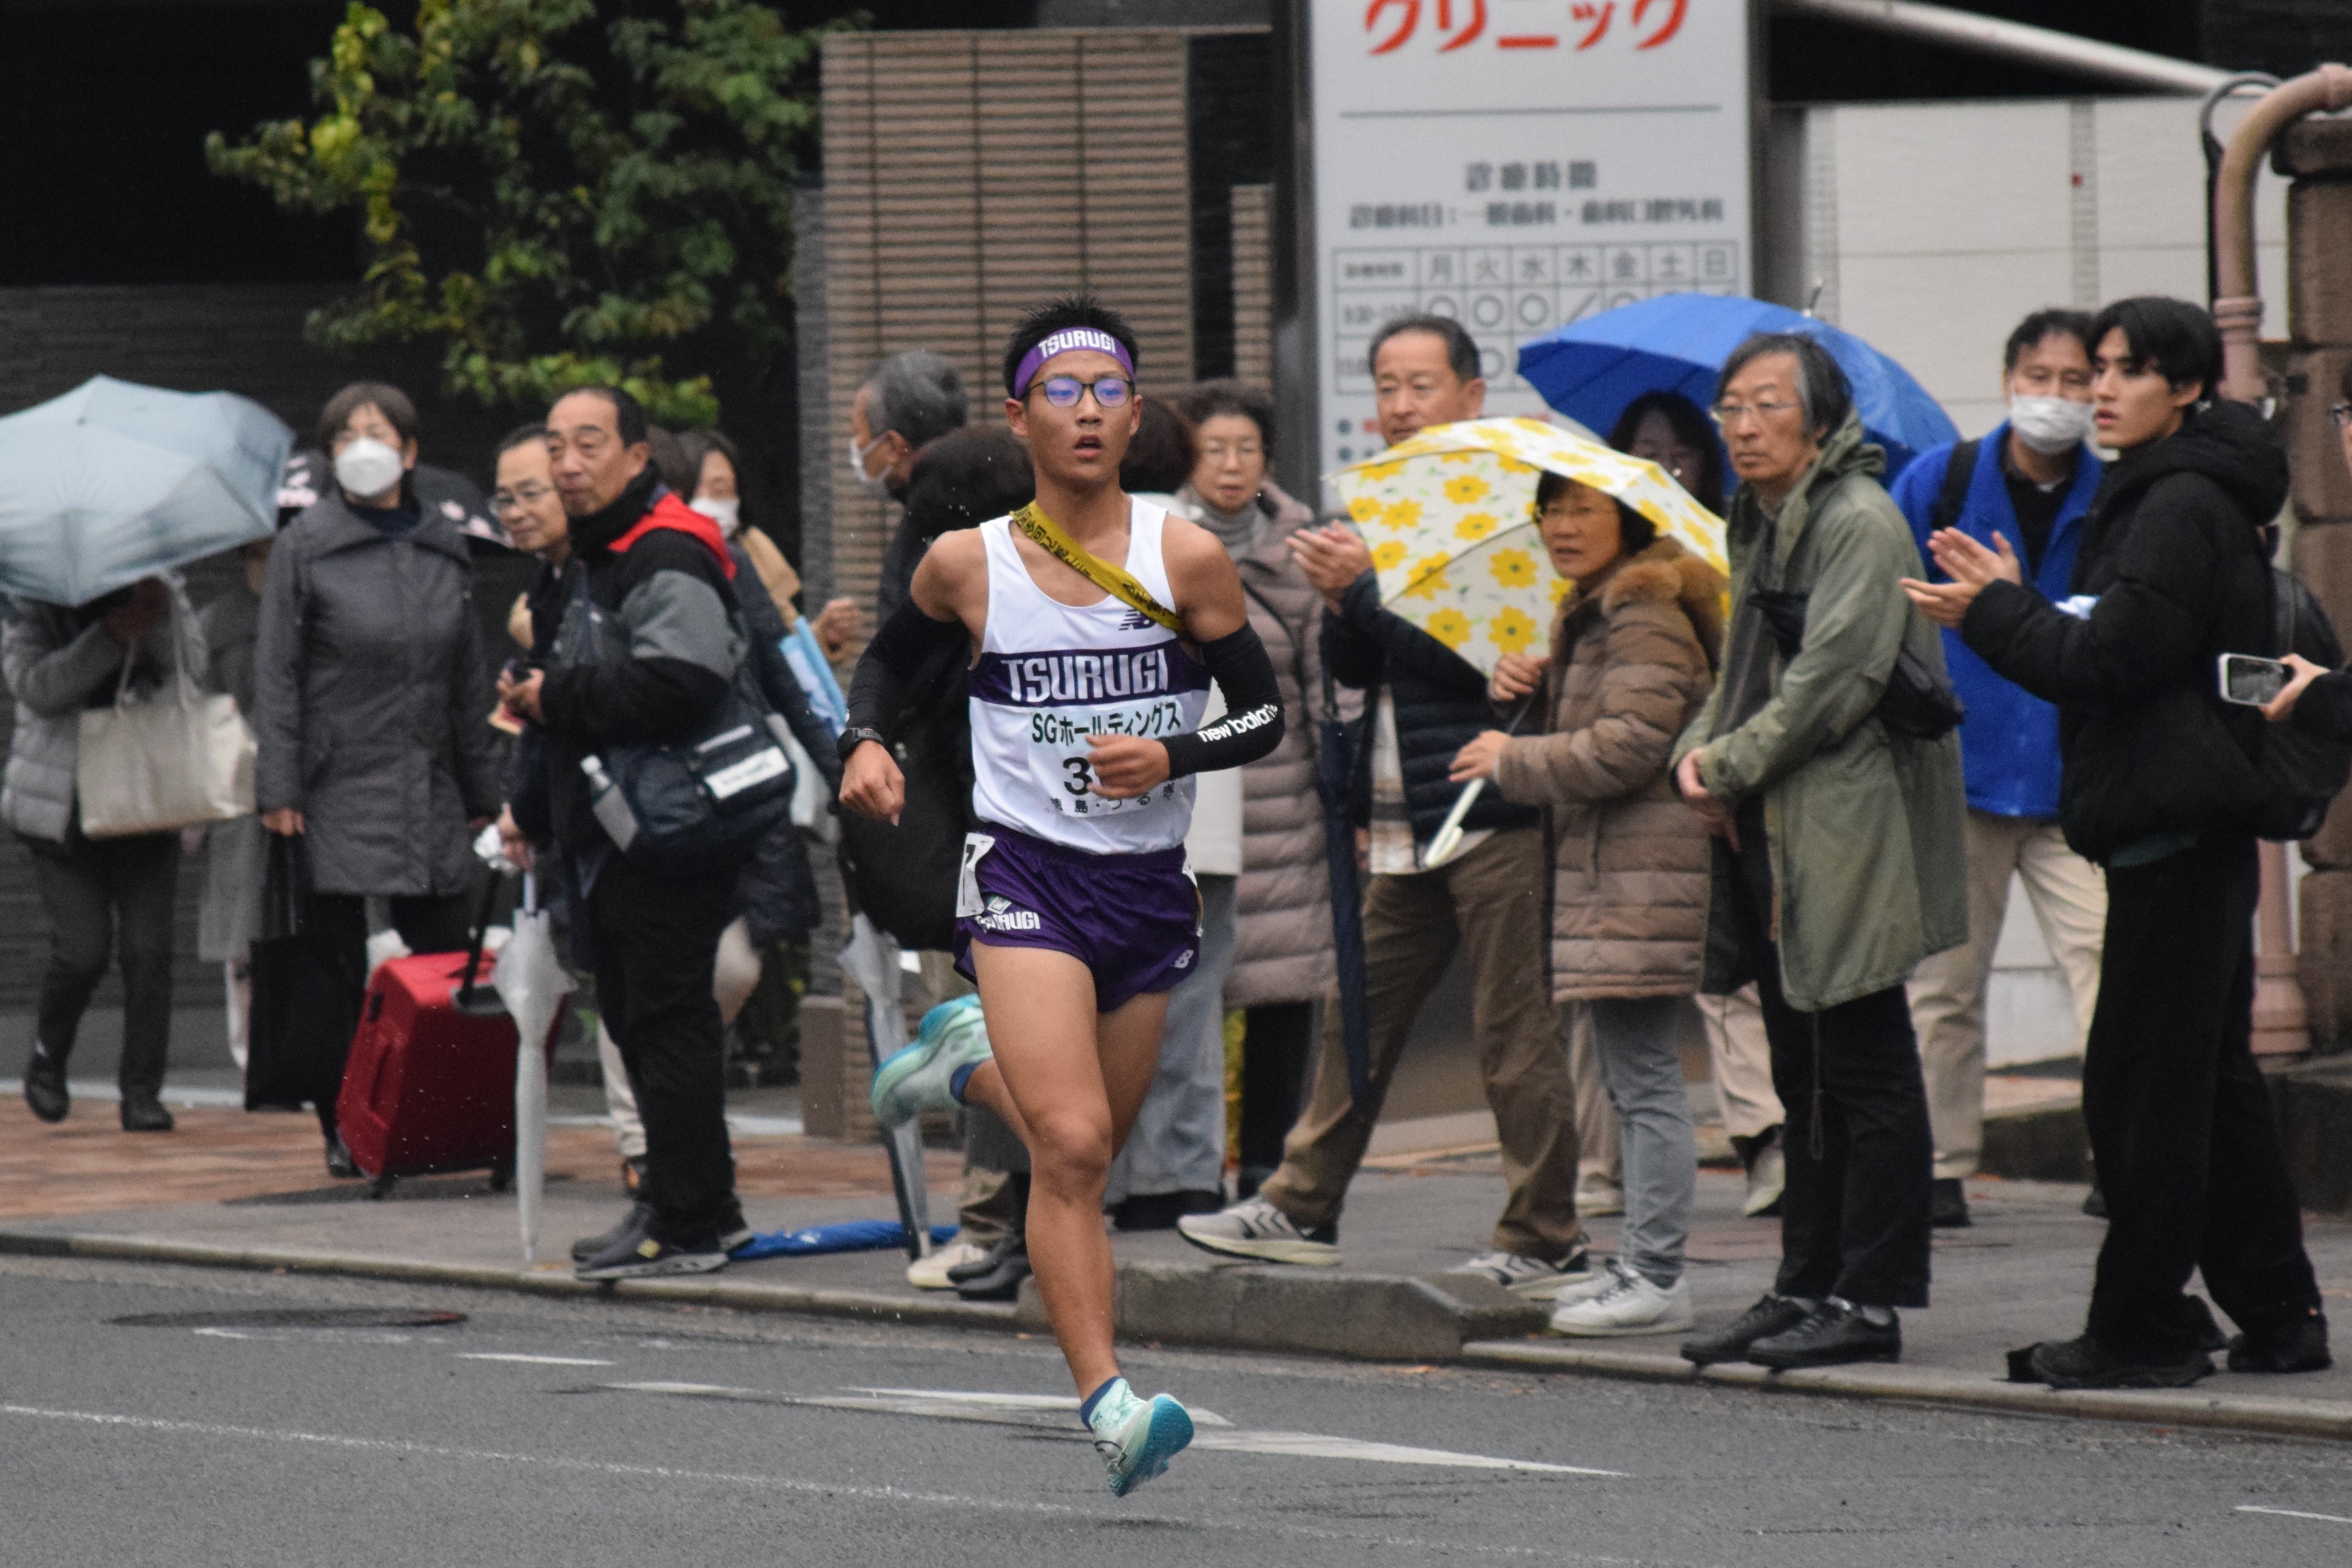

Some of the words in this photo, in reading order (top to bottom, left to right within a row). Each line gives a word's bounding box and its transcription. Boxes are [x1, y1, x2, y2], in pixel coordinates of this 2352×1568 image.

[1038, 330, 1116, 358] TSURUGI
[1000, 648, 1168, 702] TSURUGI
[1032, 701, 1182, 747] SGホールディングス
[1197, 724, 1232, 742] new
